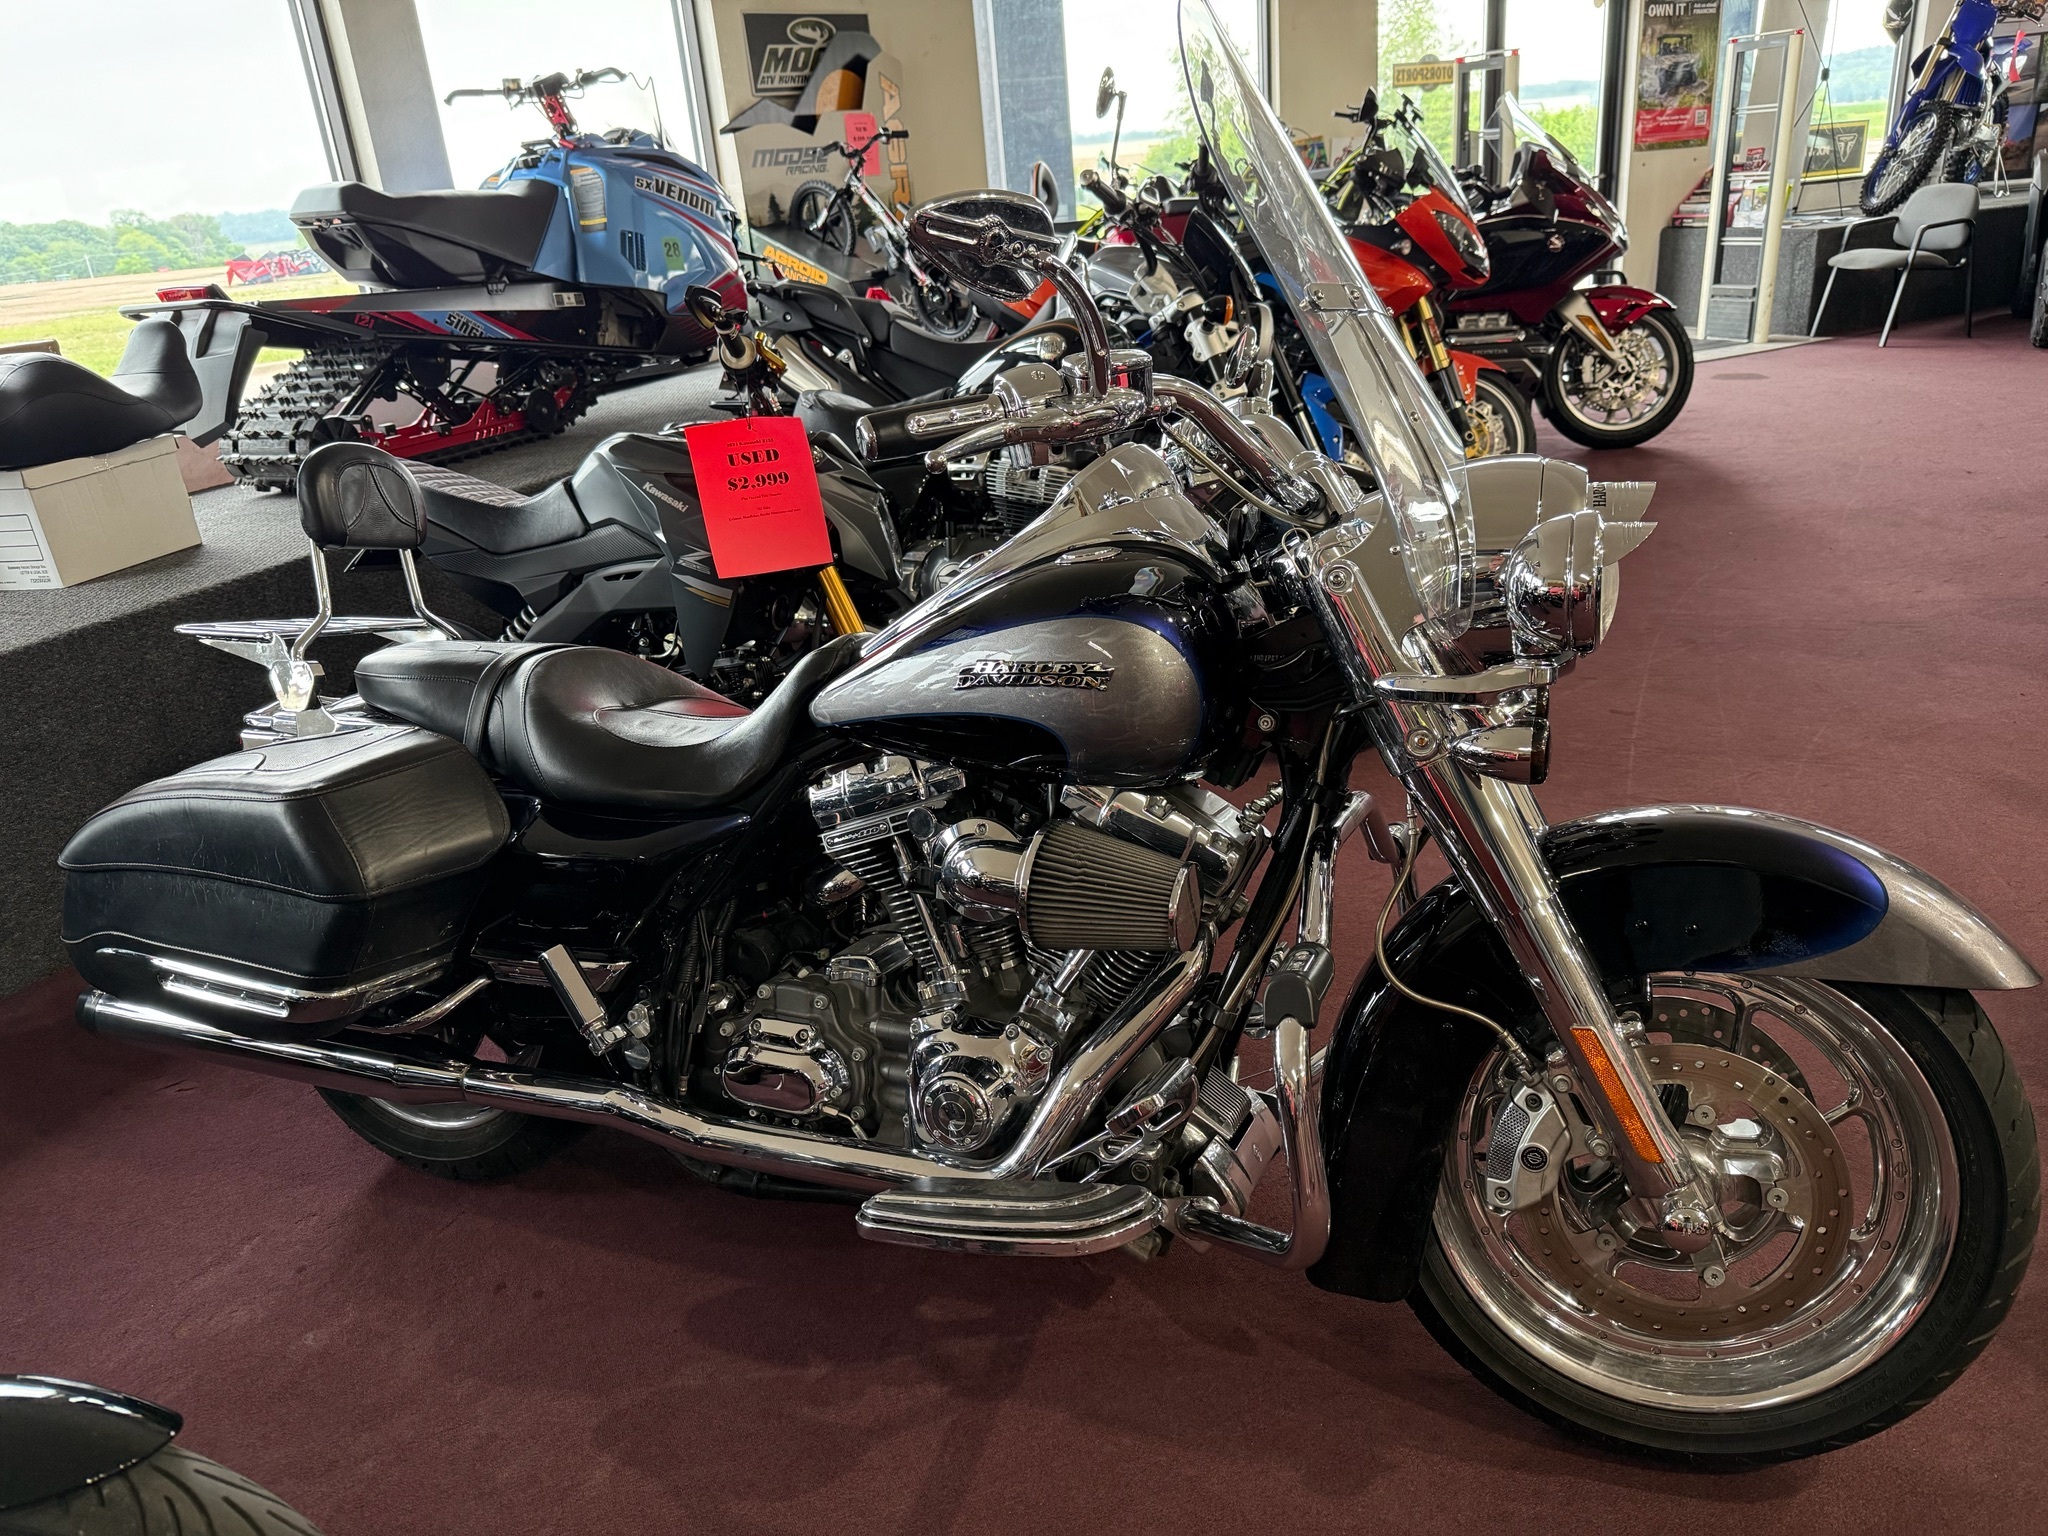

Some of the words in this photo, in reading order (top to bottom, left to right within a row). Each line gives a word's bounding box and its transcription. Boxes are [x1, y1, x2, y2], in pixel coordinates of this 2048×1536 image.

[1648, 4, 1674, 17] OWN
[1675, 3, 1687, 16] IT
[760, 75, 775, 85] ATV
[778, 74, 809, 85] HUNTIN
[663, 242, 681, 258] 28
[762, 245, 829, 285] AGROID
[353, 313, 374, 329] 121
[727, 449, 779, 467] USED
[727, 471, 789, 491] $2,999
[642, 481, 689, 513] Kawasaki
[1593, 484, 1606, 507] HAR
[970, 661, 1108, 675] HARLEY
[953, 674, 1109, 690] DAVIDSON
